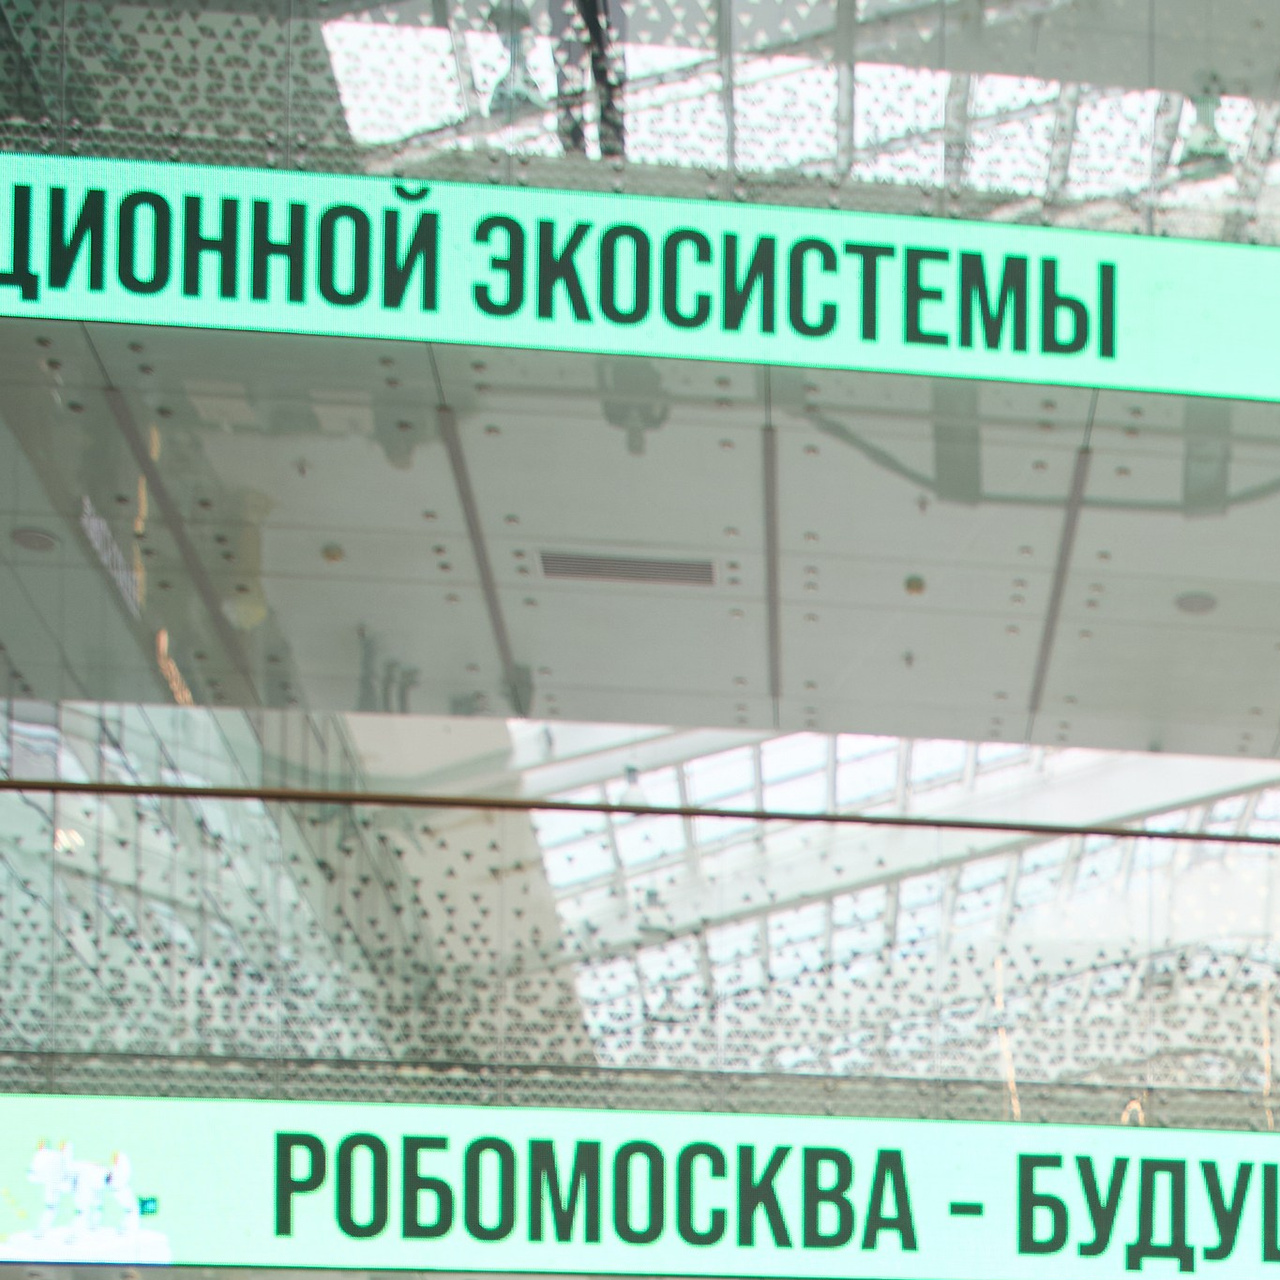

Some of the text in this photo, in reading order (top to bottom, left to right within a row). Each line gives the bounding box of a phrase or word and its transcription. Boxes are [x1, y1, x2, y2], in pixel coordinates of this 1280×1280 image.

[474, 215, 1117, 358] ЭКОСИСТЕМЫ
[274, 1132, 918, 1251] РОБОМОСКВА
[950, 1203, 984, 1216] -
